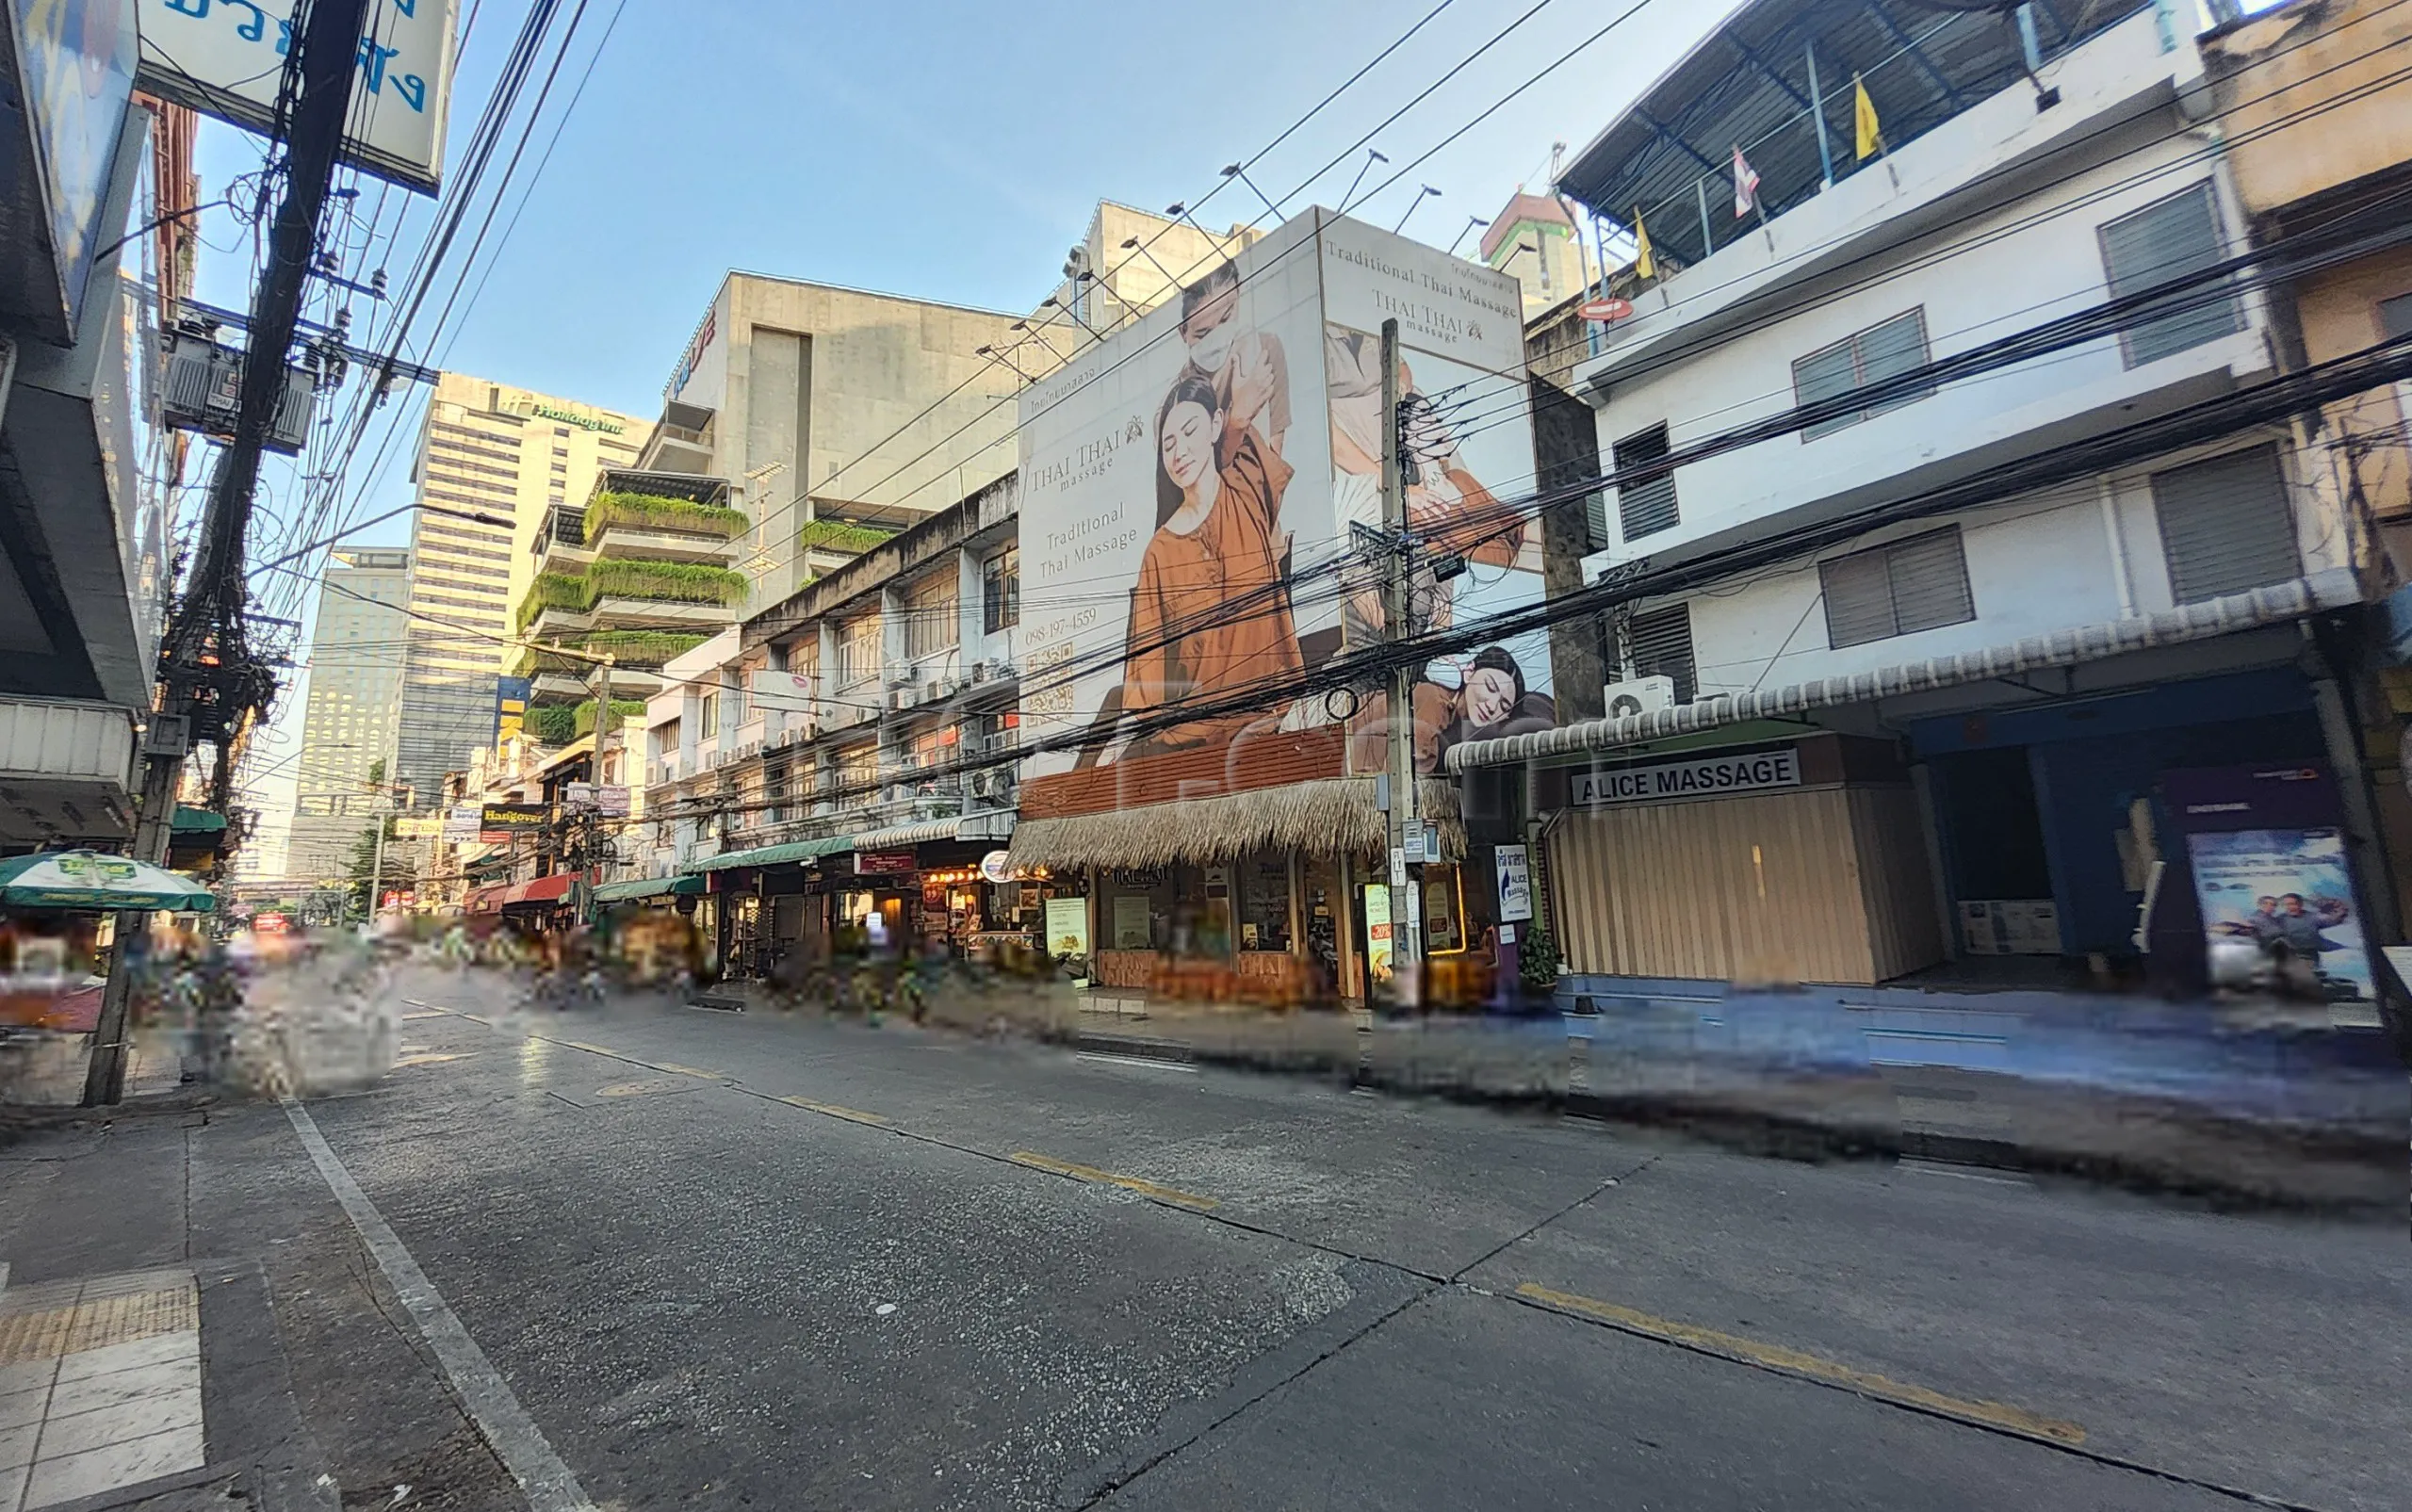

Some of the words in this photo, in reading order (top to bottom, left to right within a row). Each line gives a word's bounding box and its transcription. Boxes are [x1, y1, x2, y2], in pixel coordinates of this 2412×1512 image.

[1326, 240, 1413, 283] Traditional
[1421, 273, 1453, 297] Thai
[1459, 287, 1517, 318] Massage
[1372, 289, 1415, 319] THAI
[1422, 304, 1461, 333] THAI
[1406, 319, 1458, 344] massage
[1032, 456, 1070, 492] THAI
[1076, 430, 1119, 467] THAI
[1060, 458, 1113, 492] massage
[1047, 501, 1124, 550] Traditional
[1040, 554, 1068, 578] Thai
[1074, 528, 1137, 562] Massage
[1025, 607, 1097, 646] 098-197-4559
[1582, 773, 1649, 801] ALICE
[1656, 757, 1792, 793] MASSAGE
[484, 809, 545, 823] Hangover
[1511, 873, 1527, 884] ALICE
